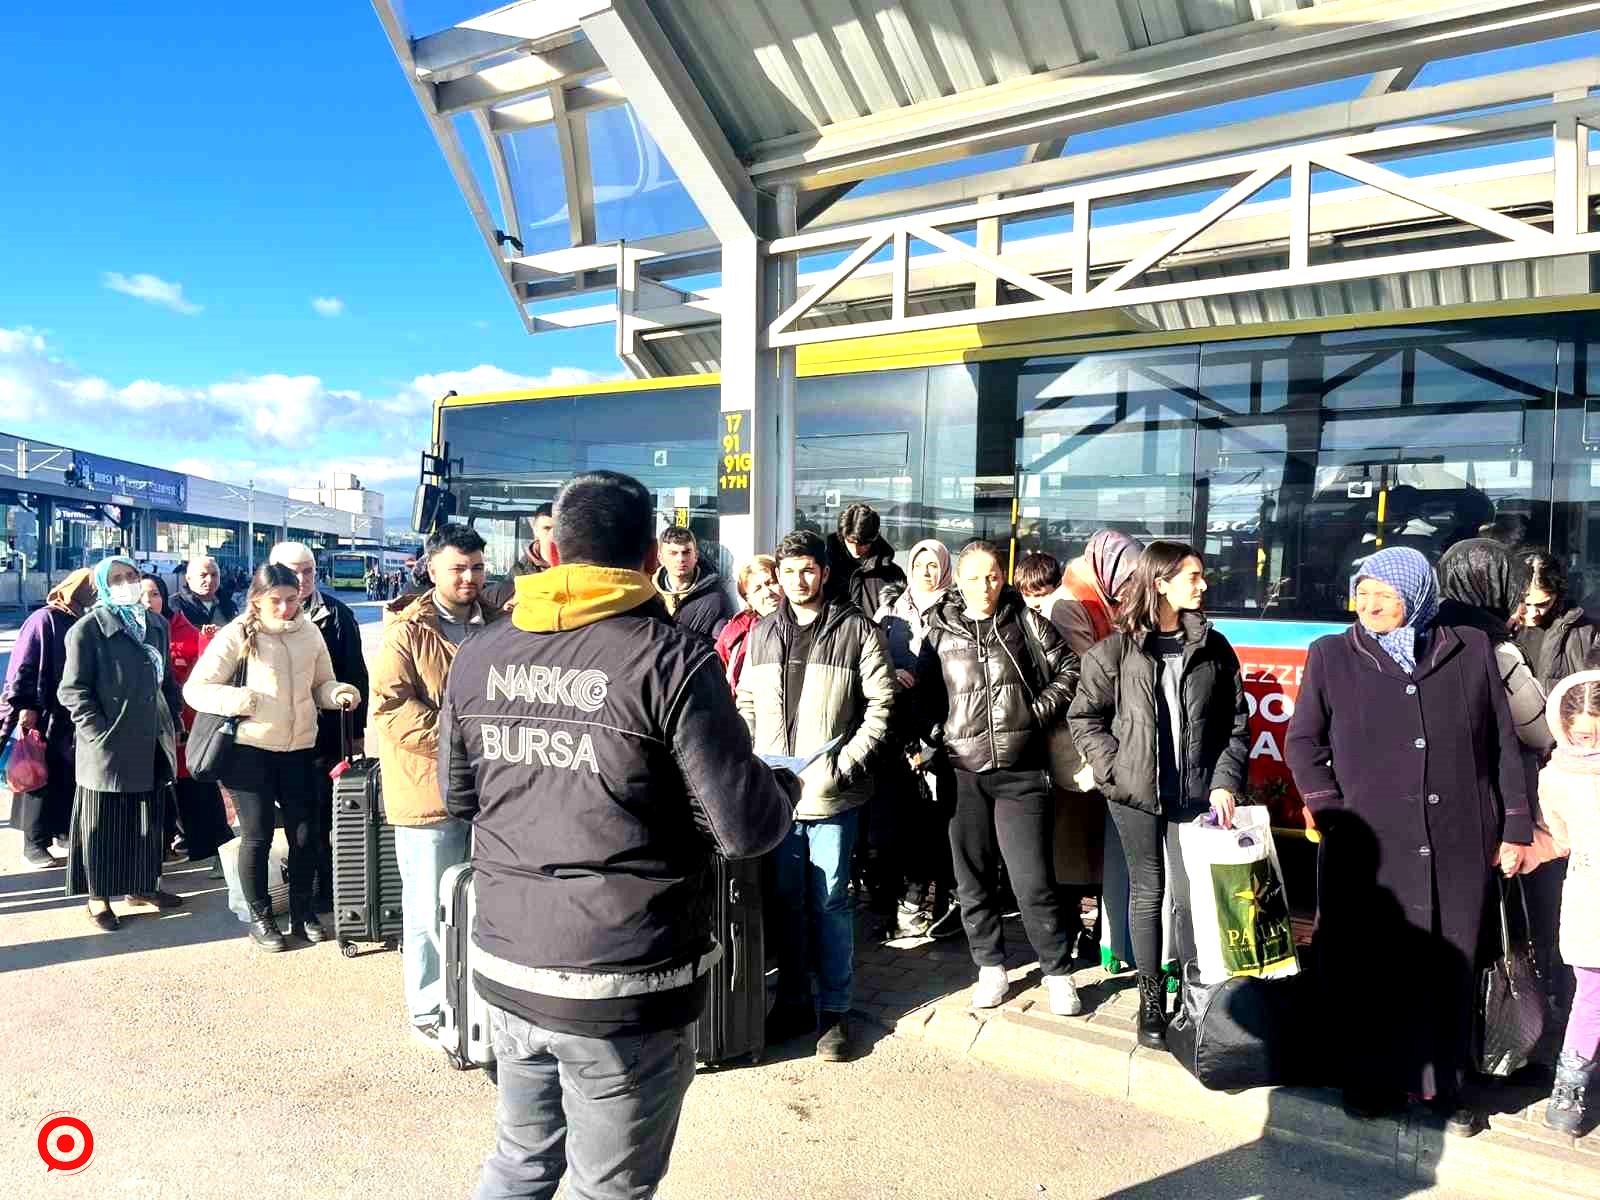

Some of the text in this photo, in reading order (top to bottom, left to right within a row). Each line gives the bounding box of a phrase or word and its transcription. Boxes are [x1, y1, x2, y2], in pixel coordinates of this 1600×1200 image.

[725, 414, 742, 433] 17
[723, 433, 739, 453] 91
[724, 452, 751, 473] 91G
[720, 475, 747, 488] 17H
[480, 723, 600, 773] BURSA
